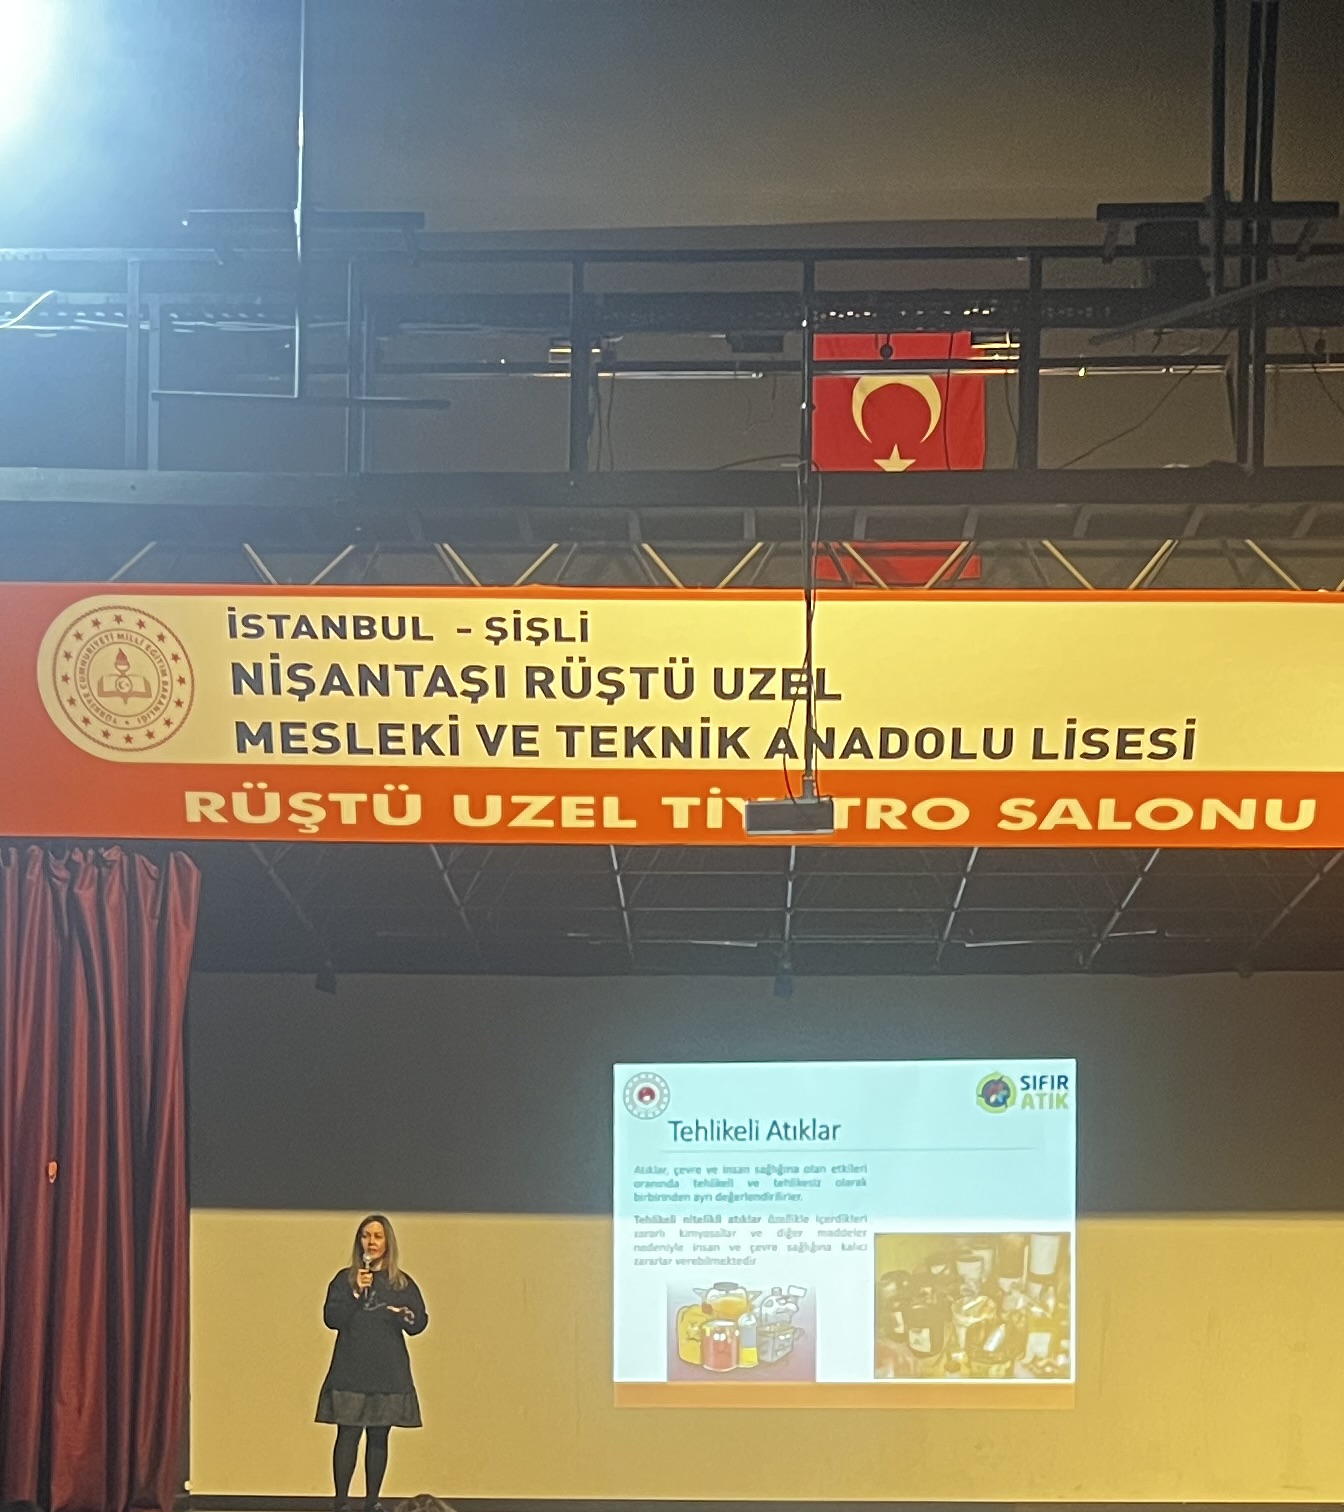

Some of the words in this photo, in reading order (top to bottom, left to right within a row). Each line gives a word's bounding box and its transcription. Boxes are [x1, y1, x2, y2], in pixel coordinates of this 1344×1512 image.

[227, 606, 434, 641] İSTANBUL
[484, 609, 589, 647] ŞİŞLİ
[231, 652, 506, 704] NİŞANTAŞI
[525, 655, 695, 706] RÜŞTÜ
[713, 667, 842, 701] UZEL
[235, 714, 460, 757] MESLEKİ
[476, 723, 539, 758] VE
[556, 716, 751, 759] TEKNİK
[763, 726, 1014, 760] ANADOLU
[1031, 717, 1197, 760] LİSESİ
[184, 781, 423, 834] RÜŞTÜ
[453, 794, 638, 829] UZEL
[661, 787, 970, 830] TİYTRO
[997, 797, 1317, 831] SALONU
[1020, 1075, 1069, 1091] SIFIR
[1020, 1092, 1069, 1110] ATIK
[667, 1118, 759, 1142] Tehlikeli
[766, 1118, 842, 1141] Atıklar
[706, 1166, 718, 1175] ve
[747, 1180, 760, 1188] ve
[750, 1230, 763, 1238] ve
[729, 1244, 741, 1252] ve
